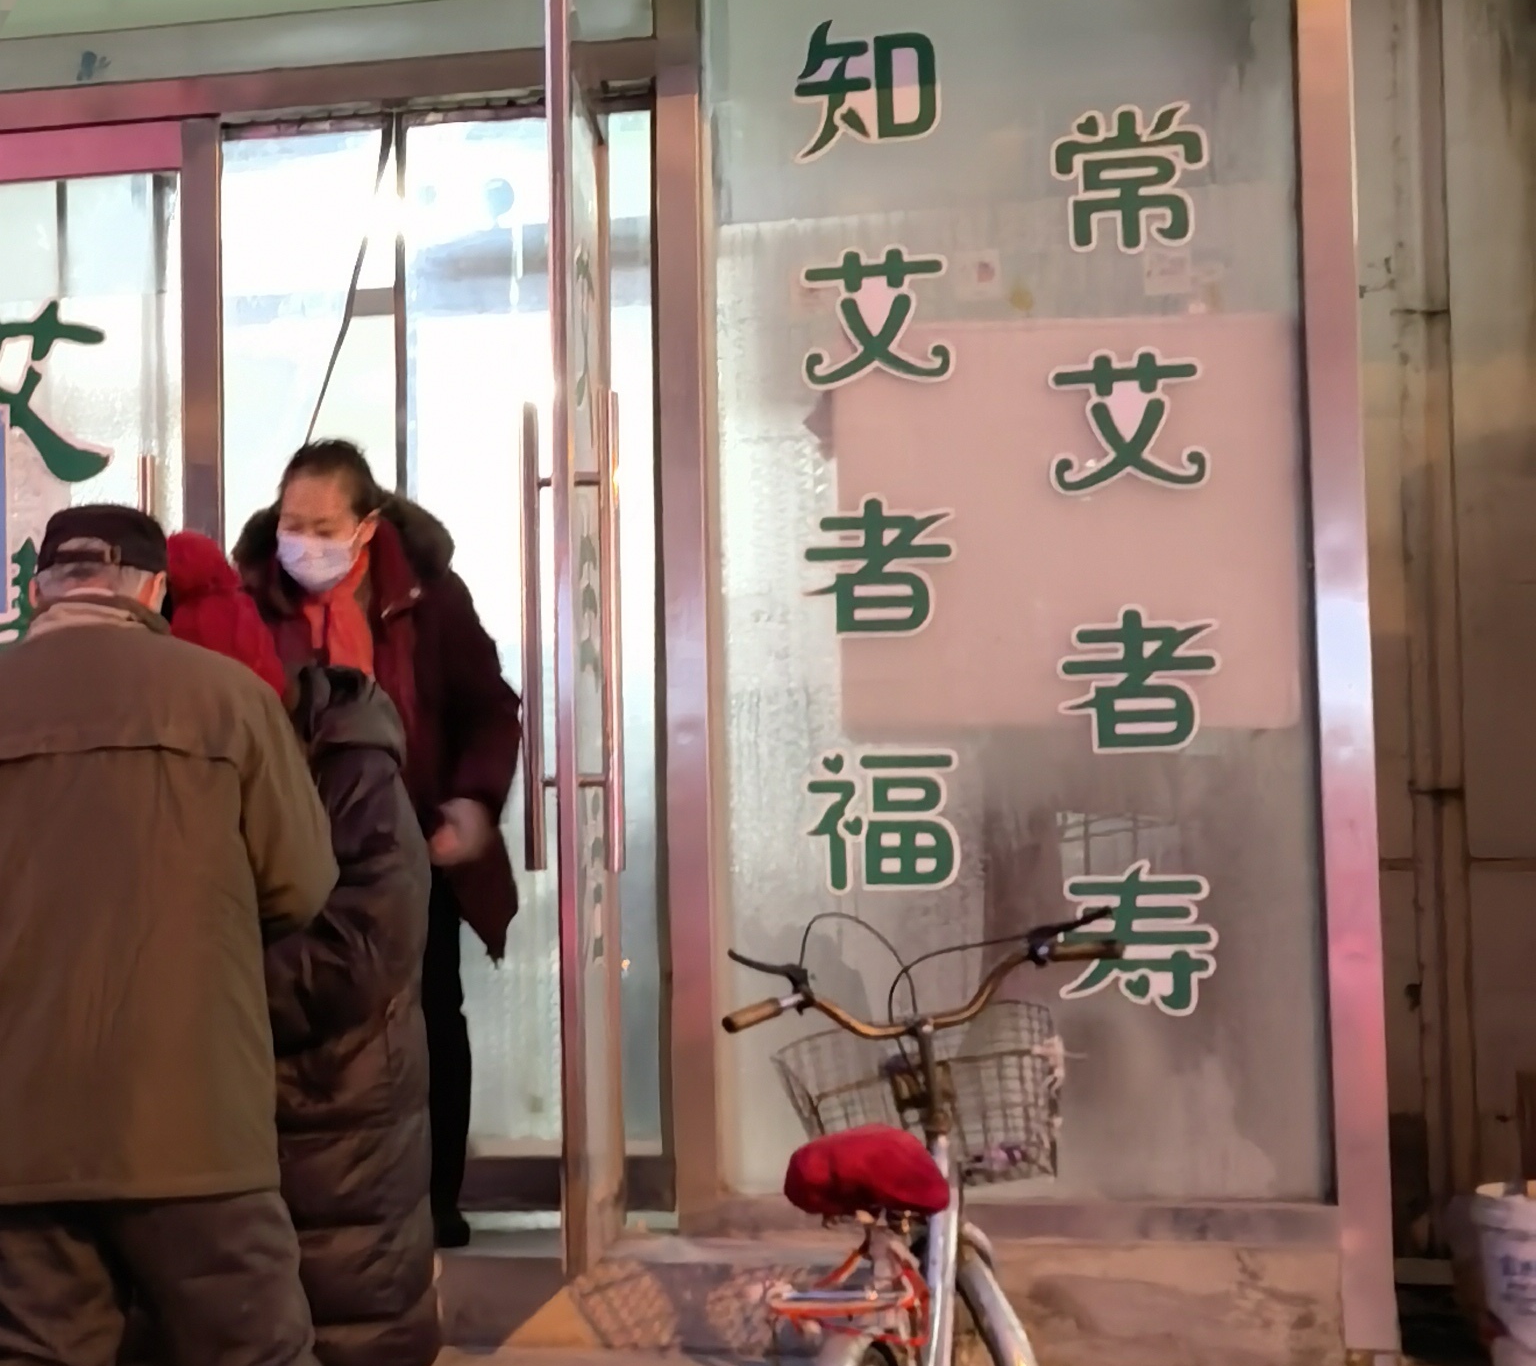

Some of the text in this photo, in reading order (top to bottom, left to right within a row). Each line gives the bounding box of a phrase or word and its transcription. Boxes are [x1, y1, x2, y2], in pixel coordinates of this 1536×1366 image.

[795, 20, 959, 894] 知艾者福
[1049, 102, 1224, 1016] 常艾者寿
